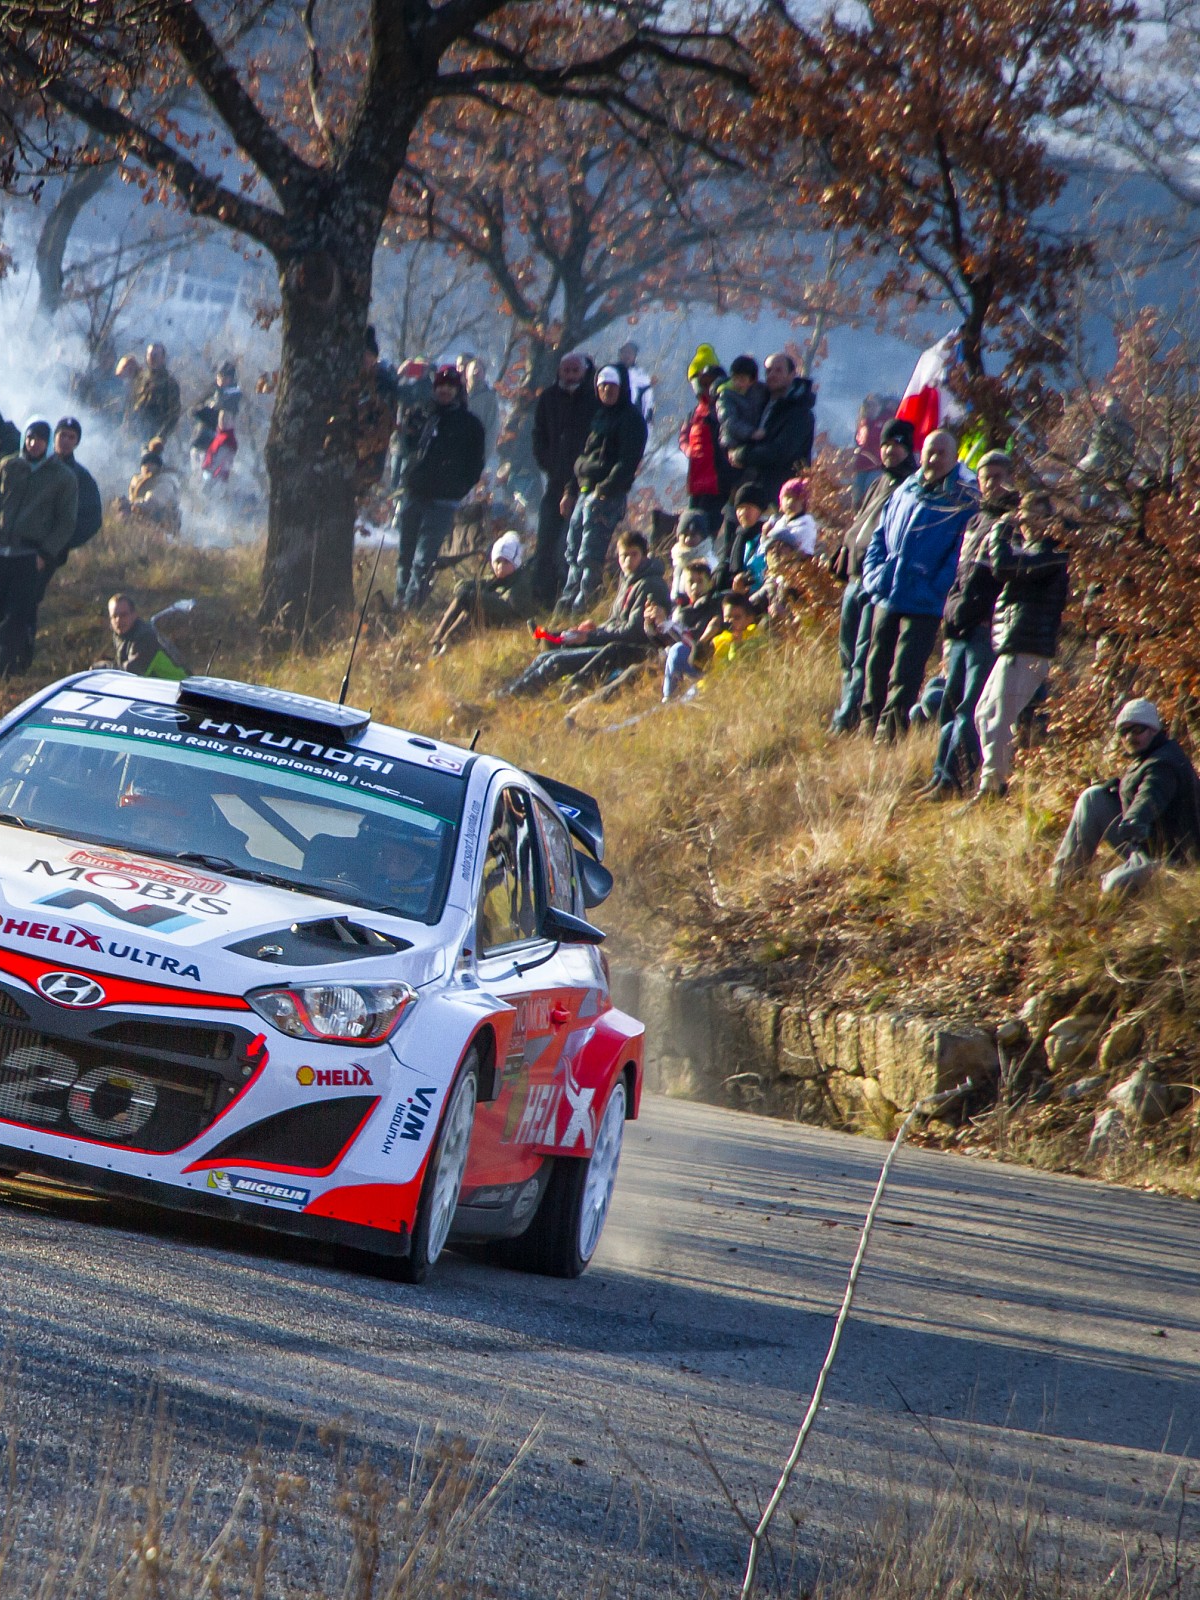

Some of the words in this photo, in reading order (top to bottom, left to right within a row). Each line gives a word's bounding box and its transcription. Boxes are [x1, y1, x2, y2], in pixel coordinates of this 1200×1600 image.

[76, 695, 104, 711] 7
[100, 722, 128, 733] FIA
[133, 727, 182, 742] World
[185, 736, 229, 752] Rally
[232, 746, 349, 782] Championship
[198, 718, 394, 775] HYUNDAI
[24, 858, 232, 916] MOBIS
[3, 918, 106, 954] HELIX
[108, 942, 202, 982] ULTRA
[315, 1063, 374, 1086] HELIX
[381, 1102, 406, 1155] HYUNDAI
[514, 1062, 596, 1149] HELIX
[235, 1178, 307, 1201] MICHELIN
